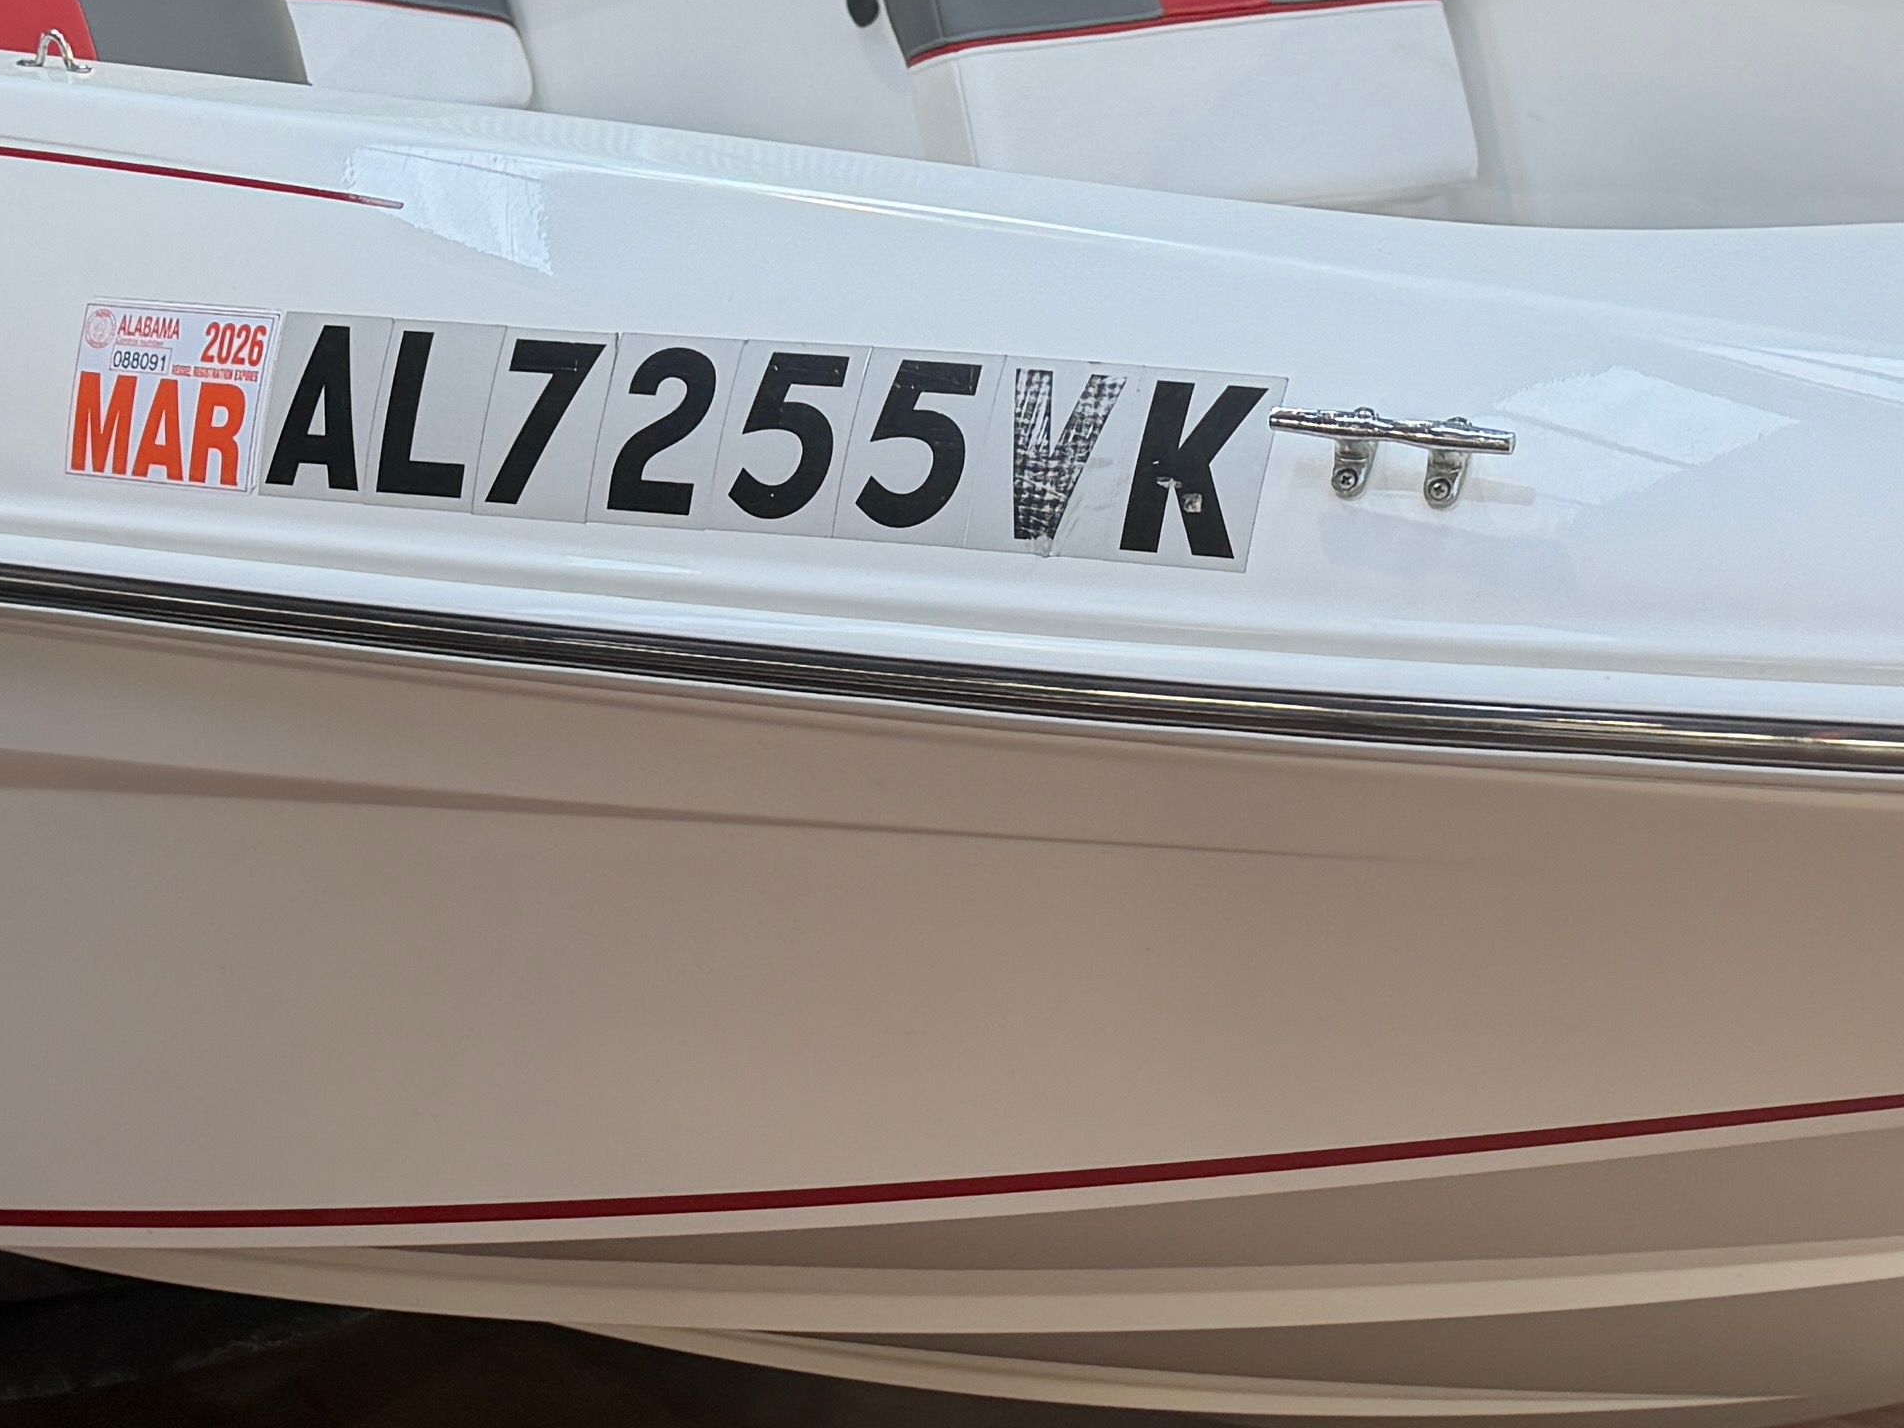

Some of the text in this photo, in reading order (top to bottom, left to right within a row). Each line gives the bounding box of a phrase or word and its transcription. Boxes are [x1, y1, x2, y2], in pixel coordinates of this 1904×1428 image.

[113, 350, 167, 372] 088091
[117, 314, 267, 367] ALABAMA 2026
[70, 370, 247, 487] MAR
